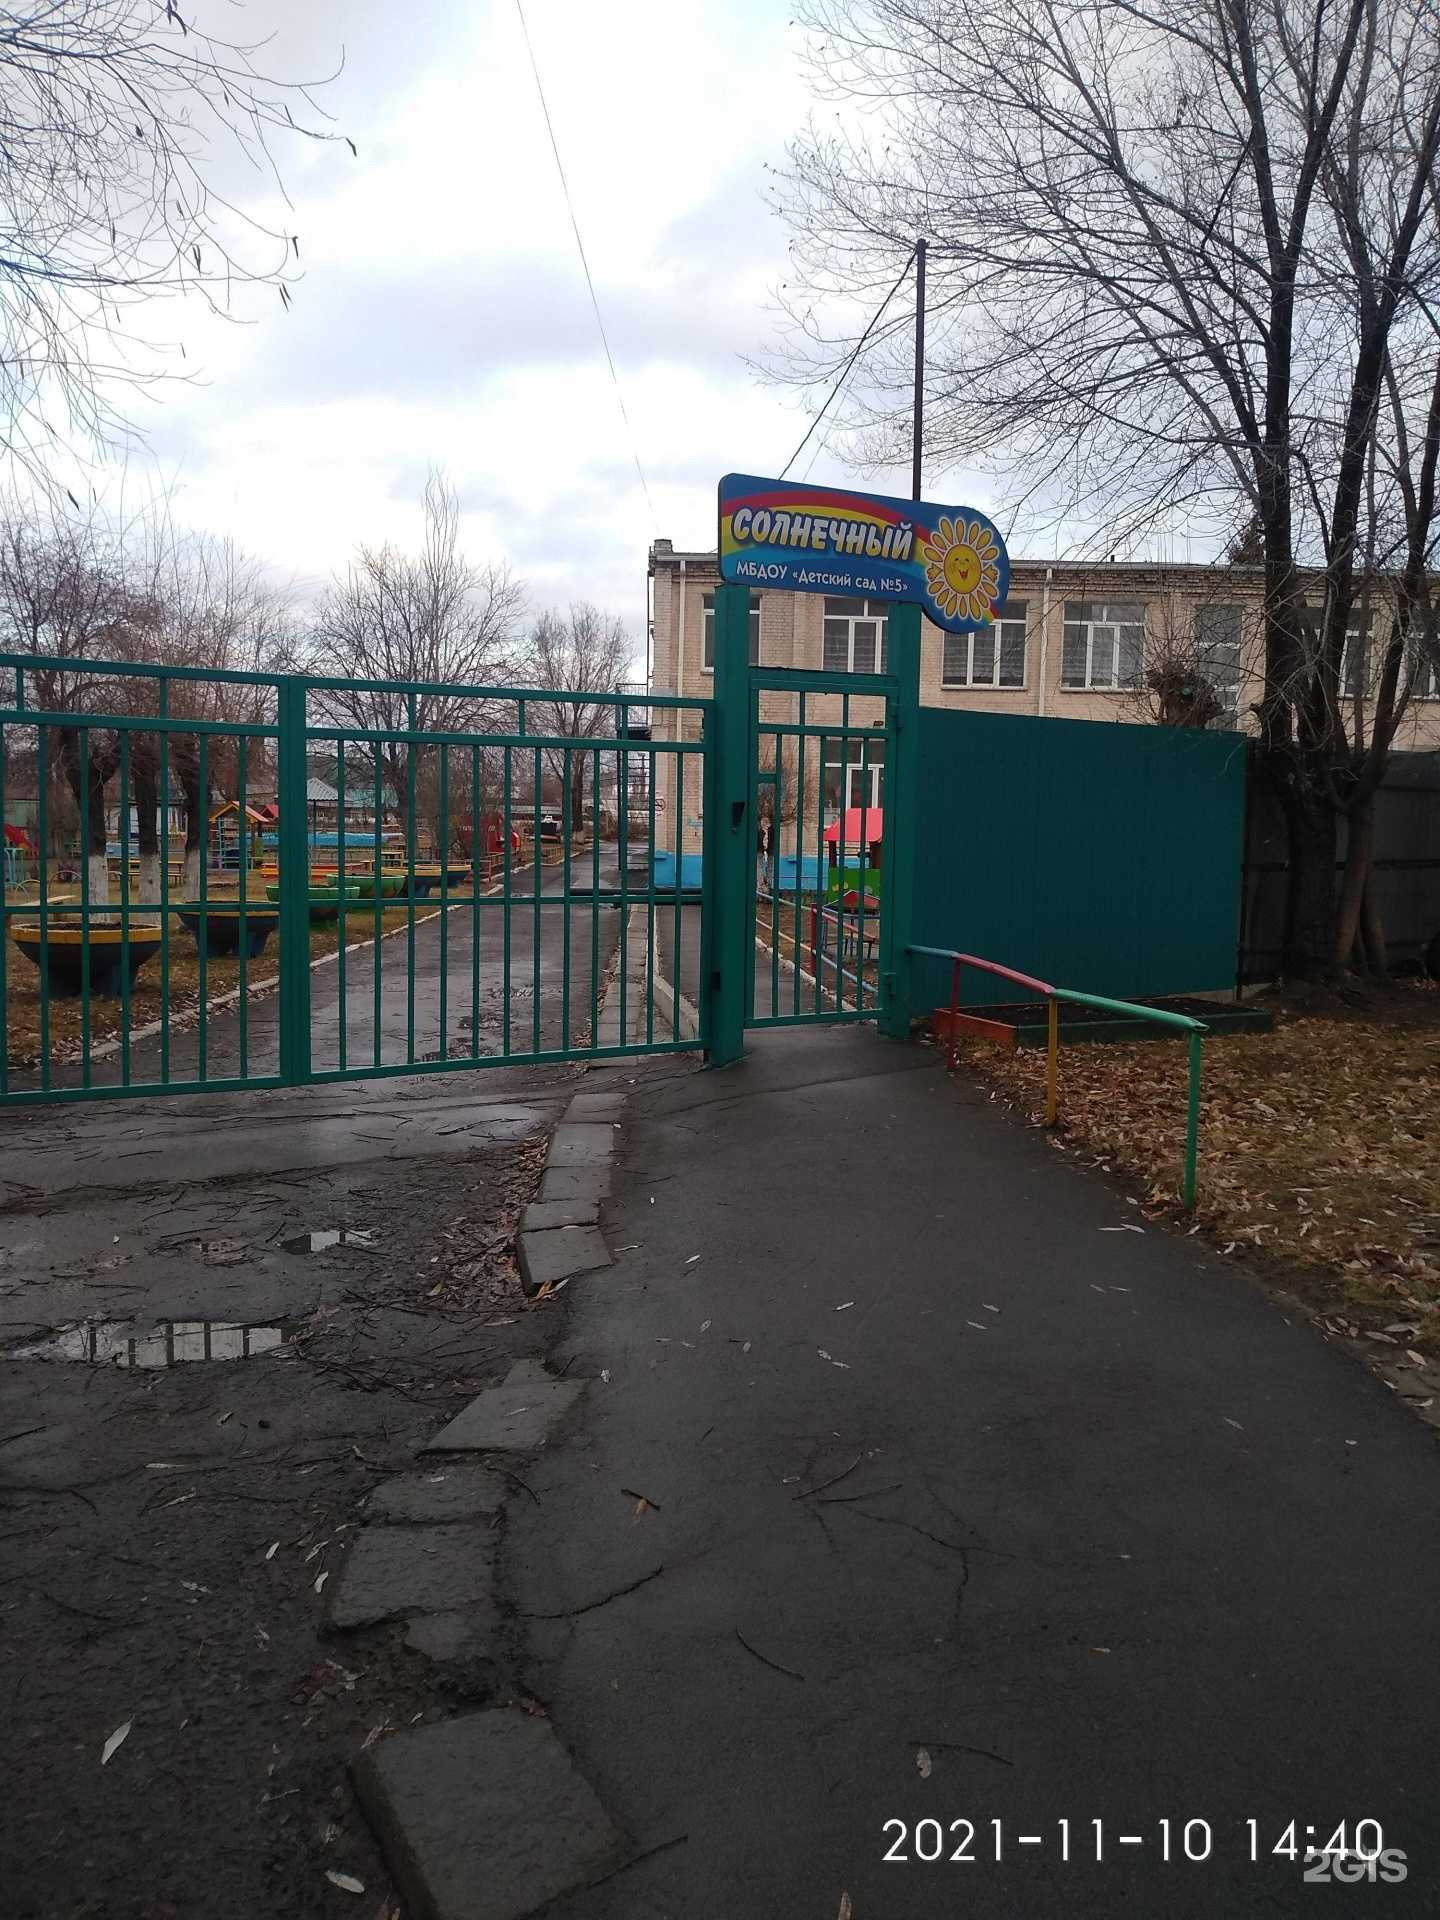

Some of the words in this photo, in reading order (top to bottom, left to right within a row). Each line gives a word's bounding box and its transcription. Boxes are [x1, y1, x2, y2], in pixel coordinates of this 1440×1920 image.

[732, 507, 913, 561] СОЛНЕЧНЫЙ
[736, 561, 788, 579] МБДОУ
[792, 568, 852, 587] «Детский
[855, 577, 877, 592] сад
[880, 579, 908, 593] №5»
